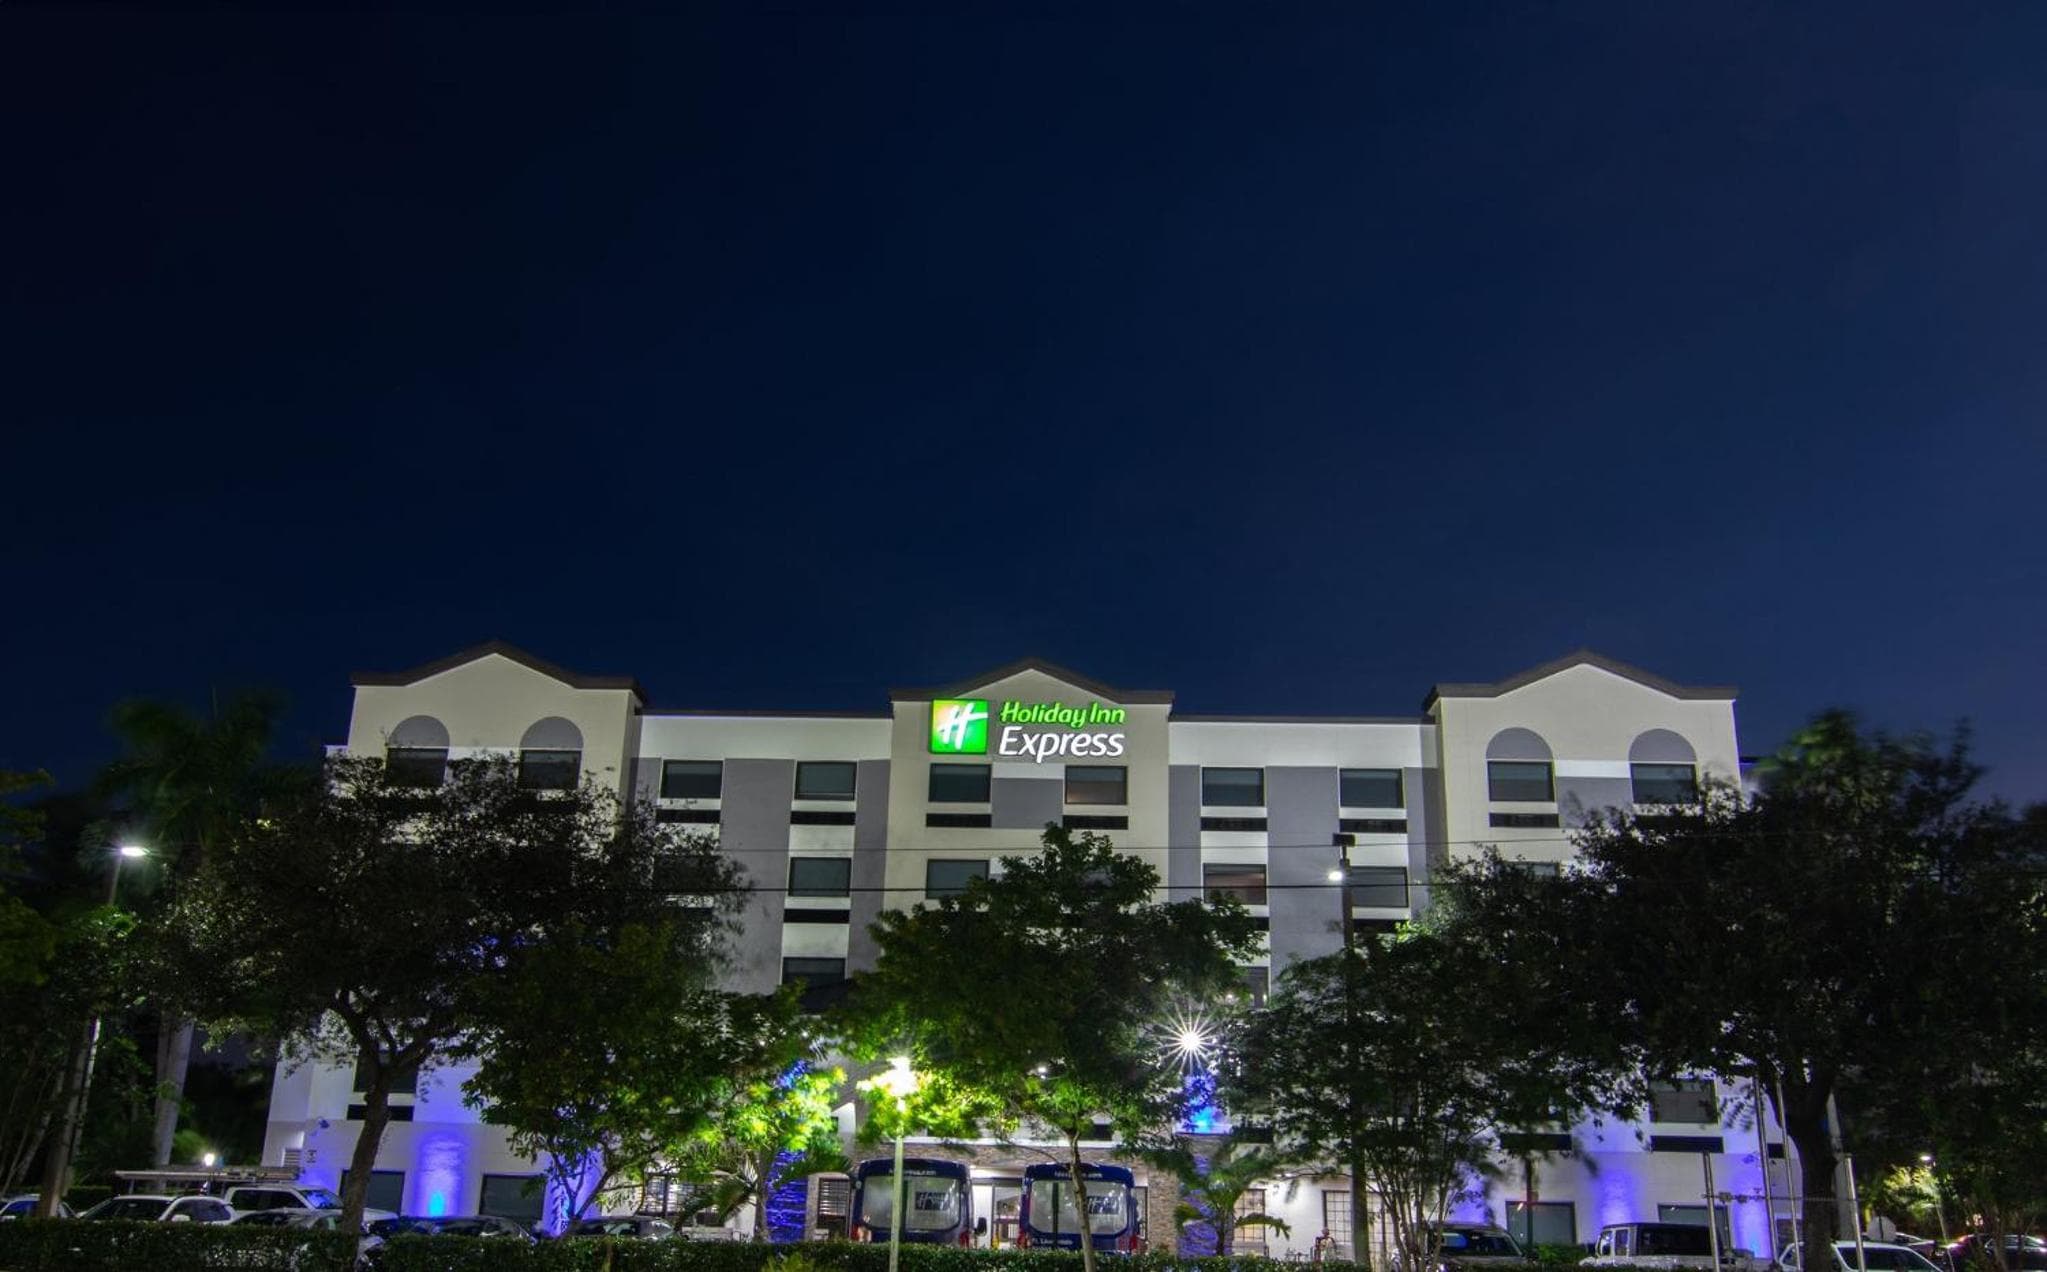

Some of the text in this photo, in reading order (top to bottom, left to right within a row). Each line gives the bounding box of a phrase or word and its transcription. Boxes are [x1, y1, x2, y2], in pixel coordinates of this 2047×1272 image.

[1000, 701, 1126, 727] Holiday Inn
[999, 726, 1125, 763] Express
